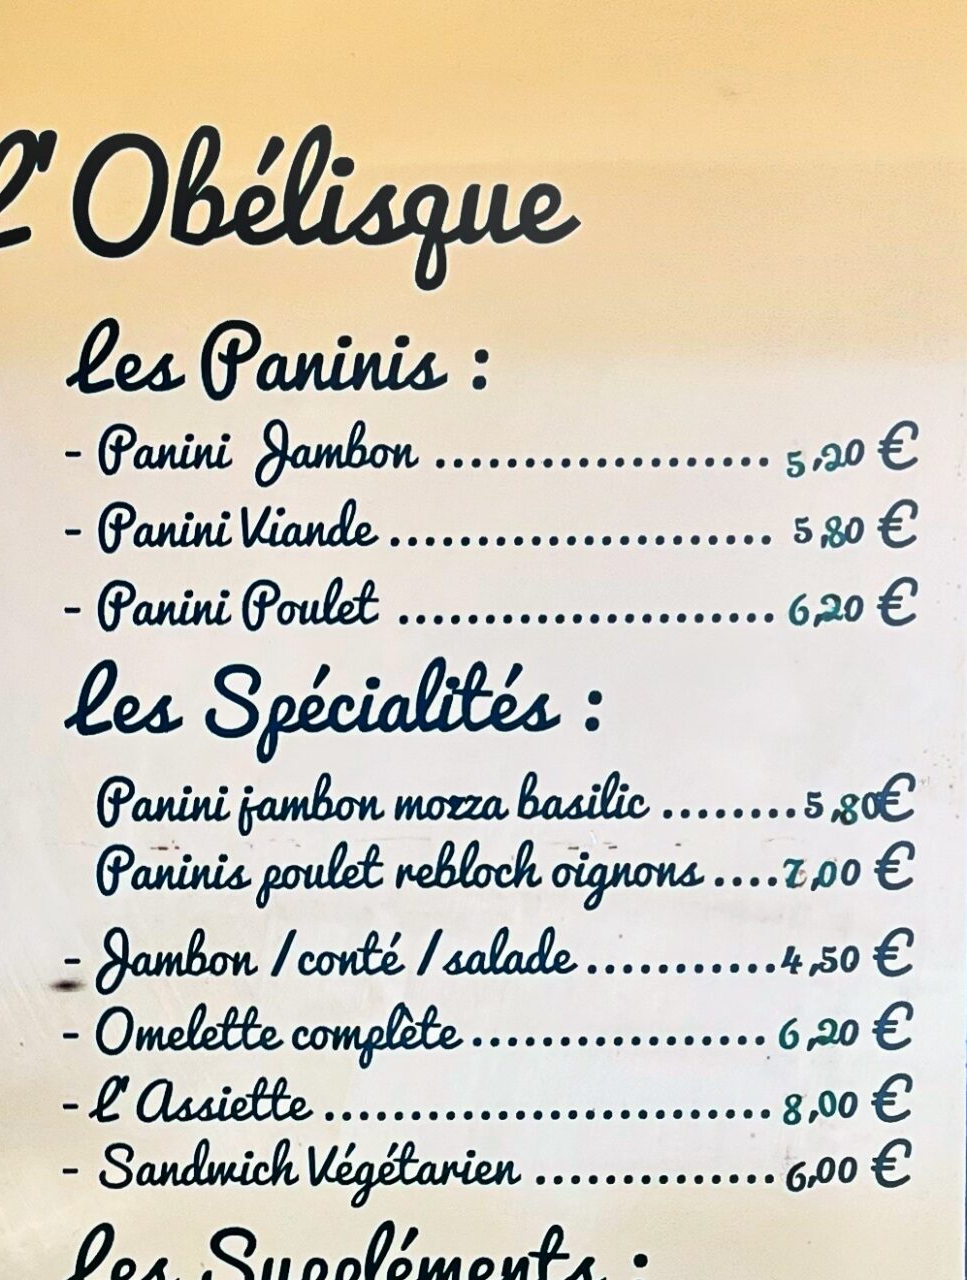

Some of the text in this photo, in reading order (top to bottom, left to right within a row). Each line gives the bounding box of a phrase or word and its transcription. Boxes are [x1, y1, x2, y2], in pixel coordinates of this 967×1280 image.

[72, 124, 582, 292] Obélisque
[200, 319, 449, 402] Paninis
[97, 418, 865, 488] Panini Jambon 5,20
[97, 497, 865, 555] Panini Viande 5,80
[97, 576, 864, 633] Panini Poulet 6,20
[204, 656, 562, 764] Spécialités
[96, 770, 916, 837] Panini jambon mozza basilic 5,80€
[96, 839, 861, 912] Paninis poulet rebloch oignons 7,00
[95, 925, 860, 996] Jambon /conté /salade 4,50
[95, 1001, 860, 1070] Omelette complète 6,20
[136, 1076, 314, 1124] Assiette
[782, 1090, 859, 1126] 8,00
[98, 1137, 858, 1209] Sandwich Végétarien 6,00
